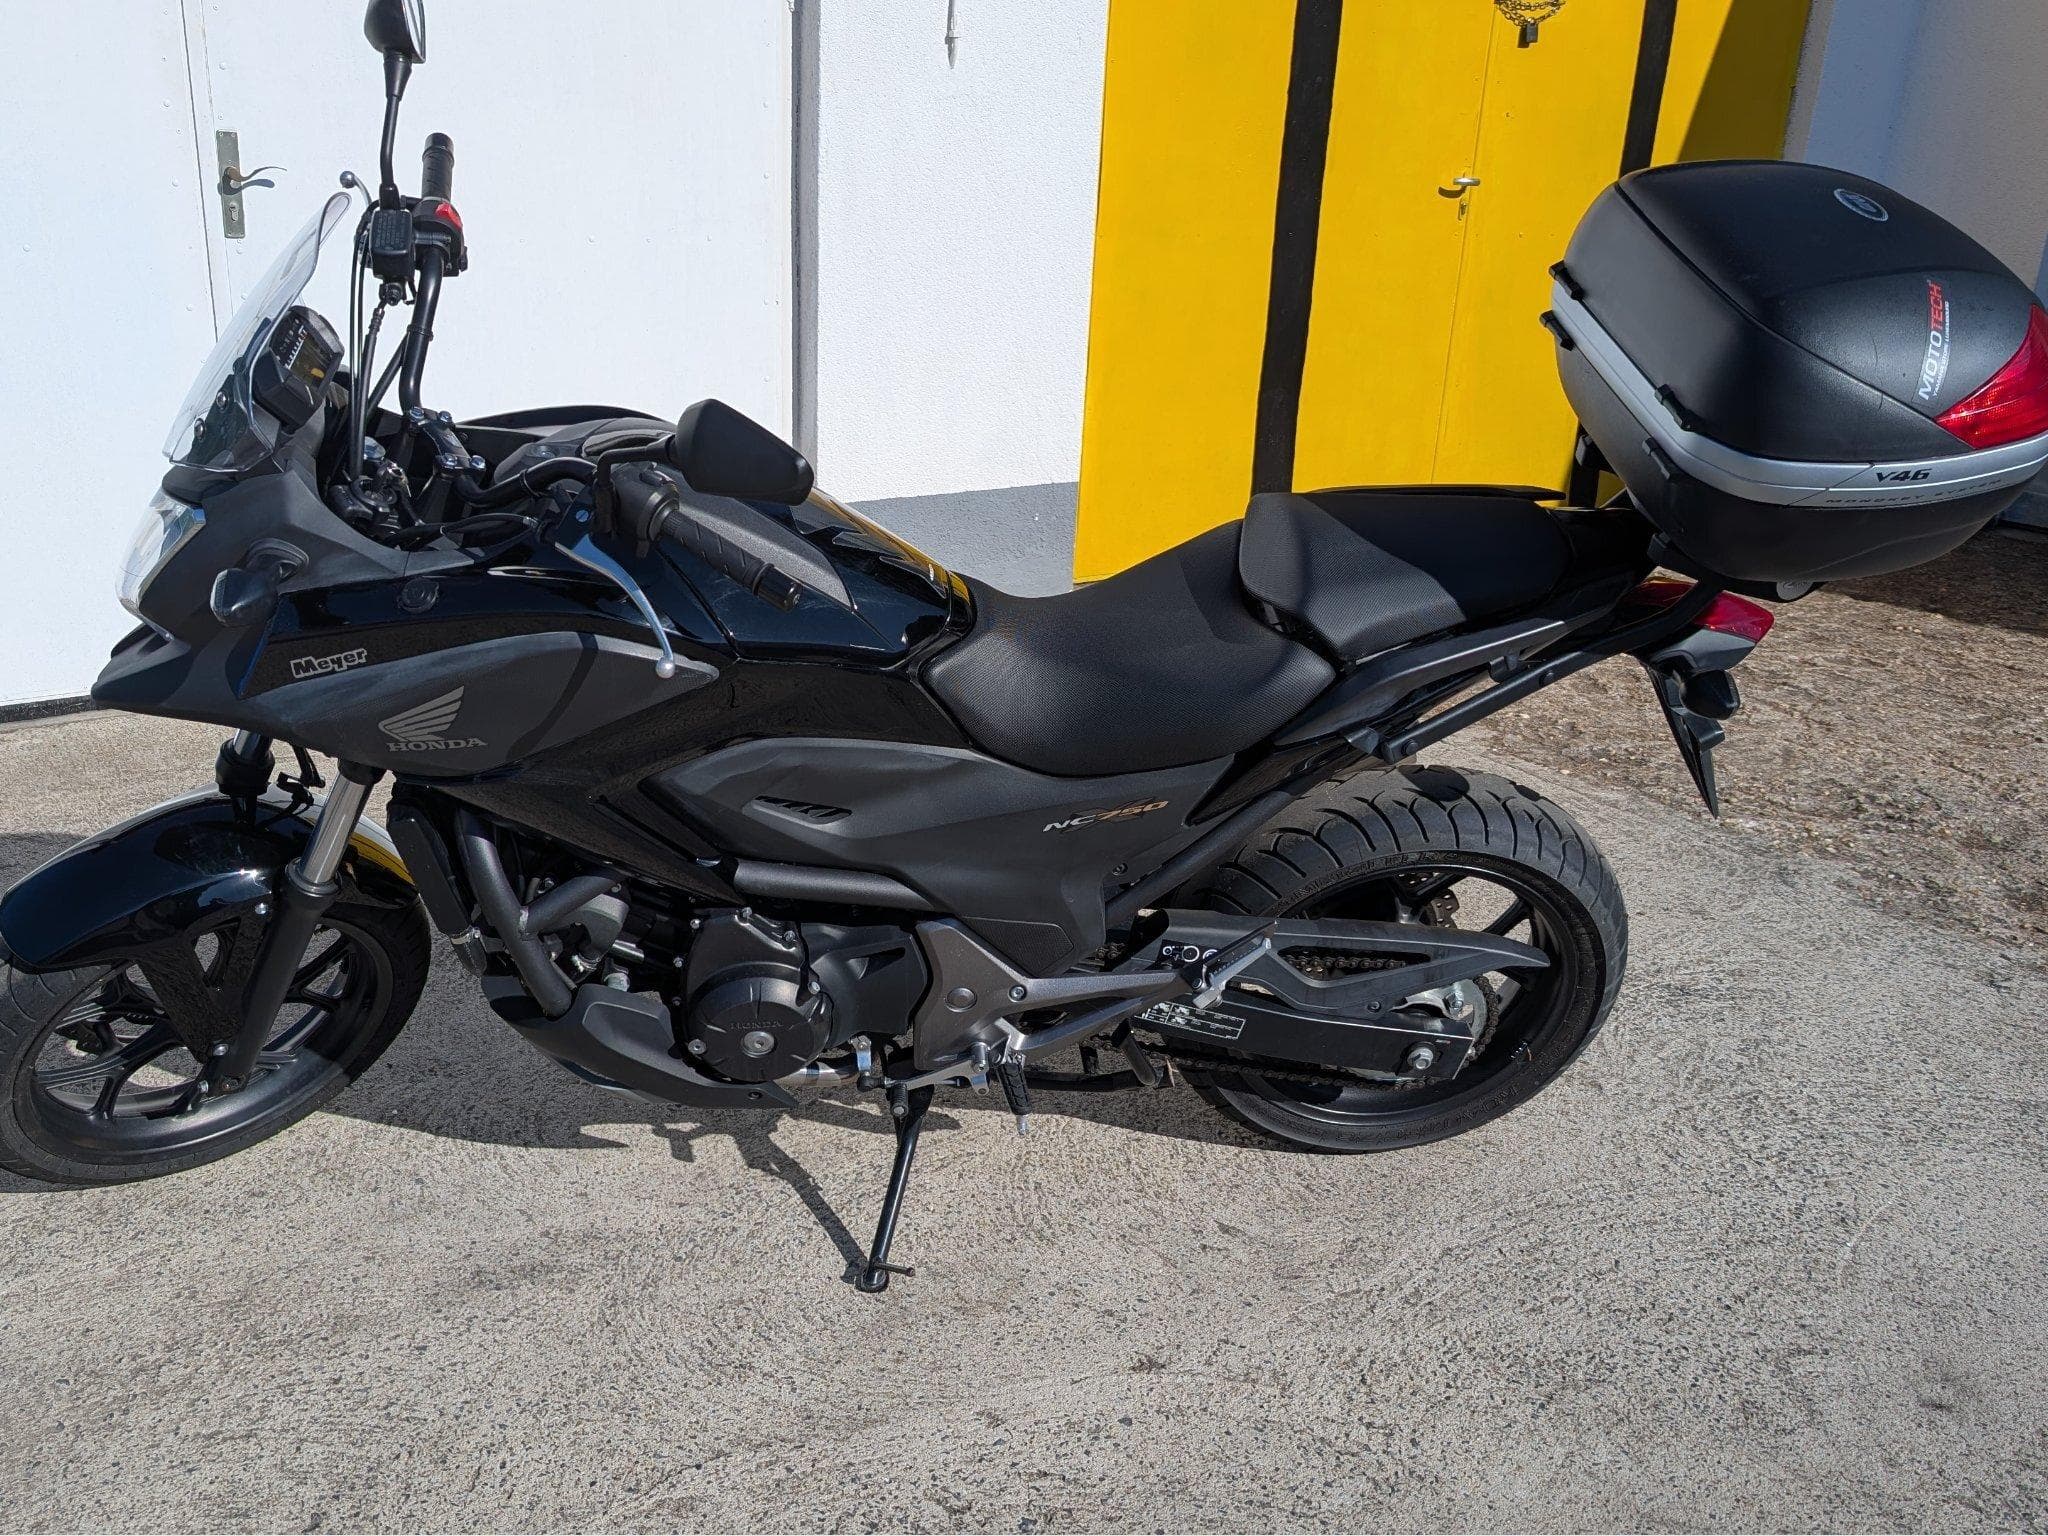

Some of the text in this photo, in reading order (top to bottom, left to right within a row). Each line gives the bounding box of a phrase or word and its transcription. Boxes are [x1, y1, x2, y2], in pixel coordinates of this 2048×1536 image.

[1919, 281, 1943, 400] MOTOTECH
[1876, 468, 1933, 483] V46
[290, 648, 367, 678] Meyer
[386, 736, 488, 752] HONDA
